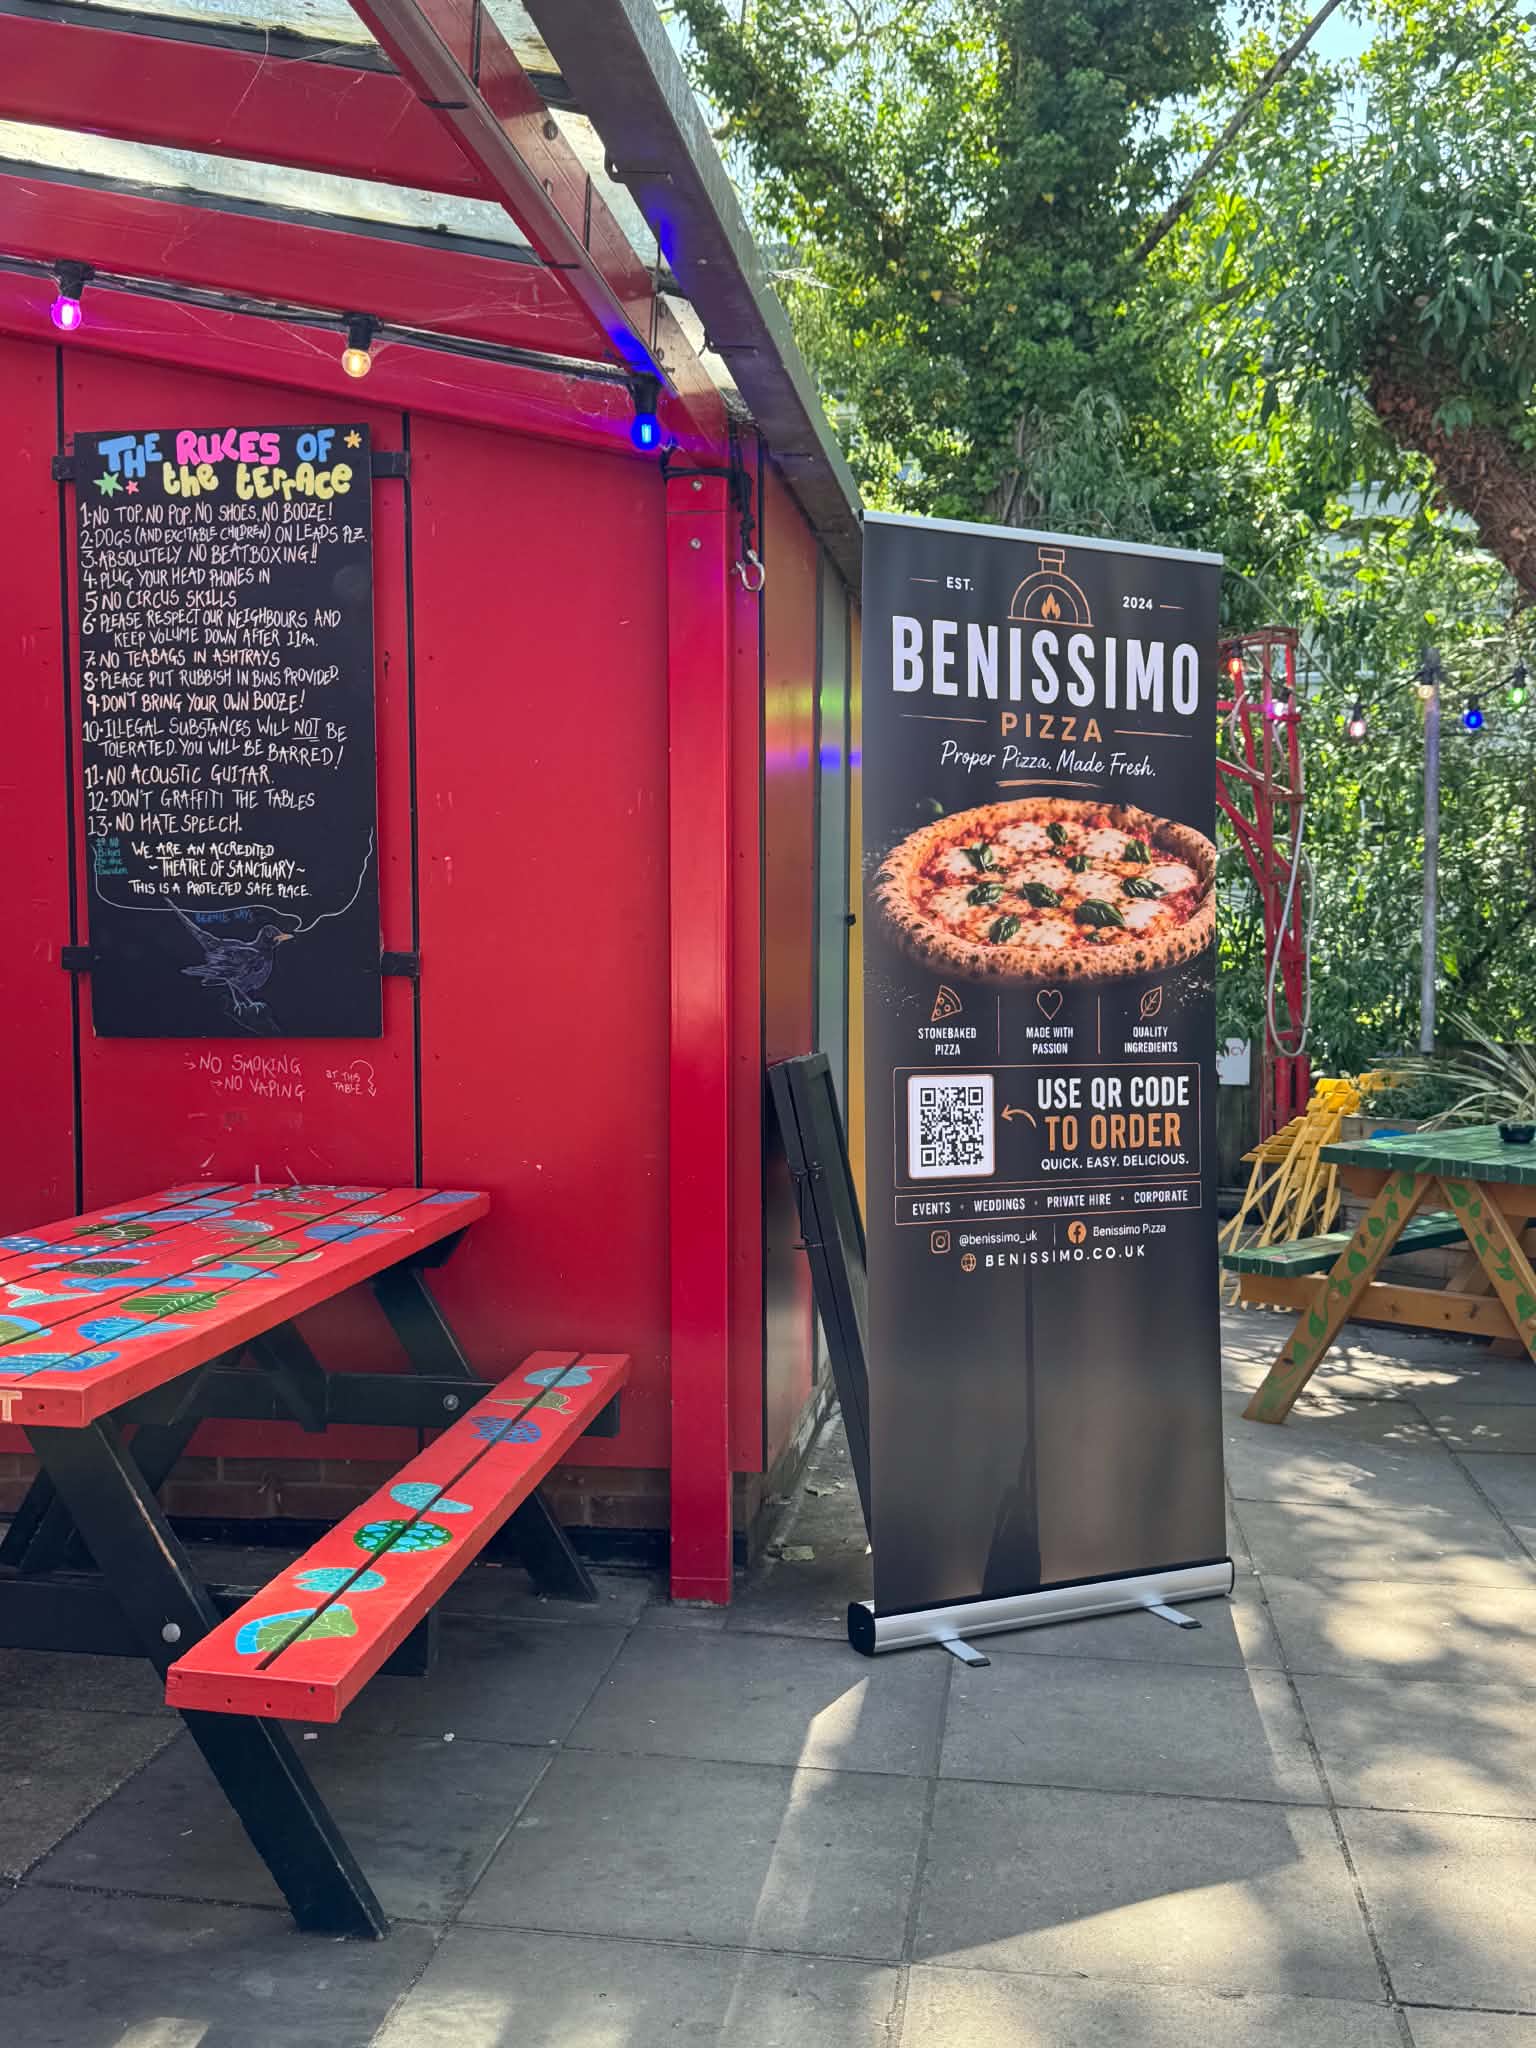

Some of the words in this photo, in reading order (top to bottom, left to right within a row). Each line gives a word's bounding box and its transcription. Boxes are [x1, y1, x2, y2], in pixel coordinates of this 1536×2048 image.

[98, 433, 162, 477] THE
[296, 428, 336, 462] OF
[93, 504, 109, 528] NO
[145, 504, 163, 523] NO
[194, 501, 212, 523] NO
[261, 501, 278, 521] NO
[281, 502, 333, 523] BOOZE!
[95, 528, 131, 548] DOGS
[134, 526, 162, 546] (AND
[164, 526, 217, 544] EXCITABLE
[220, 522, 271, 544] CHILDREN)
[275, 525, 292, 543] ON
[296, 523, 338, 544] LEADS
[99, 545, 182, 571] ABSOLUTELY
[187, 544, 207, 563] NO
[100, 567, 134, 590] PLUG
[136, 567, 168, 588] YOUR
[171, 566, 205, 586] HEAD
[209, 566, 254, 587] PHONES
[258, 567, 270, 584] IN
[946, 576, 975, 591] EST.
[101, 591, 121, 611] NO
[126, 589, 179, 609] CIRCUS
[185, 589, 237, 608] SKILLS
[1122, 596, 1153, 610] 2024
[99, 611, 143, 633] PLEASE
[146, 608, 200, 628] RESPECT
[202, 608, 224, 626] OUR
[227, 607, 308, 629] NEIGHBOURS
[314, 608, 341, 628] AND
[114, 631, 145, 648] KEEP
[149, 626, 199, 644] VOLUME
[204, 628, 236, 646] DOWN
[242, 628, 280, 648] AFTER
[99, 650, 120, 669] NO
[123, 648, 186, 668] TEABAGS
[193, 648, 207, 664] IN
[212, 648, 280, 667] ASHTRAYS
[892, 615, 1199, 716] BENISSIMO
[100, 670, 145, 690] PLEASE
[148, 669, 174, 688] PUT
[179, 666, 232, 687] RUBBISH
[236, 669, 249, 686] IN
[252, 670, 281, 688] BINS
[283, 665, 340, 687] PROVIDED.
[141, 693, 182, 714] BRING
[186, 692, 219, 714] YOUR
[223, 691, 249, 711] OWN
[253, 688, 306, 714] BOOZE!
[103, 716, 164, 739] ILLEGAL
[168, 715, 251, 739] SUBSTANCES
[256, 714, 290, 737] WILL
[294, 718, 321, 737] NOT
[325, 721, 348, 743] BE
[1001, 712, 1102, 743] PIZZA
[178, 738, 203, 756] YOU
[207, 738, 240, 756] WILL
[243, 739, 264, 757] BE
[266, 743, 344, 770] BARRED!
[940, 739, 996, 774] Proper
[1001, 744, 1053, 771] Pizza.
[1055, 749, 1104, 774] Made
[1109, 752, 1157, 777] Fresh.
[105, 764, 126, 786] NO
[130, 763, 201, 785] ACOUSTIC
[110, 788, 153, 810] DON'T
[160, 788, 223, 810] GRAFFITI
[231, 789, 259, 809] THE
[264, 788, 316, 811] TABLES
[115, 812, 134, 832] NO
[140, 812, 179, 835] HATE
[180, 811, 243, 834] SPEECH.
[131, 840, 153, 859] WE
[155, 841, 182, 858] ARE
[186, 842, 205, 855] AN
[209, 840, 274, 860] ACCREDITED
[156, 856, 207, 878] THEATRE
[210, 860, 225, 877] OF
[127, 879, 155, 895] THIS
[159, 882, 169, 894] IS
[171, 882, 180, 894] A
[186, 880, 241, 897] PROTECTED
[245, 881, 274, 896] SAFE
[918, 1028, 977, 1039] STONEBAKED
[1026, 1026, 1050, 1038] MADE
[1053, 1026, 1074, 1037] WITH
[1133, 1026, 1168, 1038] QUALITY
[935, 1045, 961, 1055] PIZZA
[1032, 1043, 1068, 1054] PASSION
[1124, 1041, 1178, 1053] INGREDIENTS
[199, 1052, 222, 1074] NO
[232, 1053, 302, 1078] SMOKING
[224, 1074, 243, 1092] NO
[250, 1078, 304, 1103] VAPING
[1037, 1077, 1082, 1109] USE
[1090, 1077, 1123, 1111] QR
[1130, 1075, 1190, 1108] CODE
[1044, 1115, 1079, 1152] TO
[1090, 1112, 1181, 1149] ORDER
[1041, 1157, 1083, 1171] QUICK.
[1086, 1155, 1120, 1169] EASY.
[1123, 1153, 1189, 1167] DELICIOUS.
[912, 1201, 951, 1216] EVENTS
[974, 1197, 1026, 1212] WEDDINGS
[1046, 1194, 1086, 1208] PRIVATE
[1088, 1192, 1112, 1206] HIRE
[1133, 1189, 1188, 1204] CORPORATE
[959, 1229, 1038, 1246] @benissimo_uk
[1093, 1222, 1141, 1238] Benissimo
[1142, 1222, 1167, 1236] Pizza
[985, 1244, 1146, 1268] BENISSIMO.CO.UK
